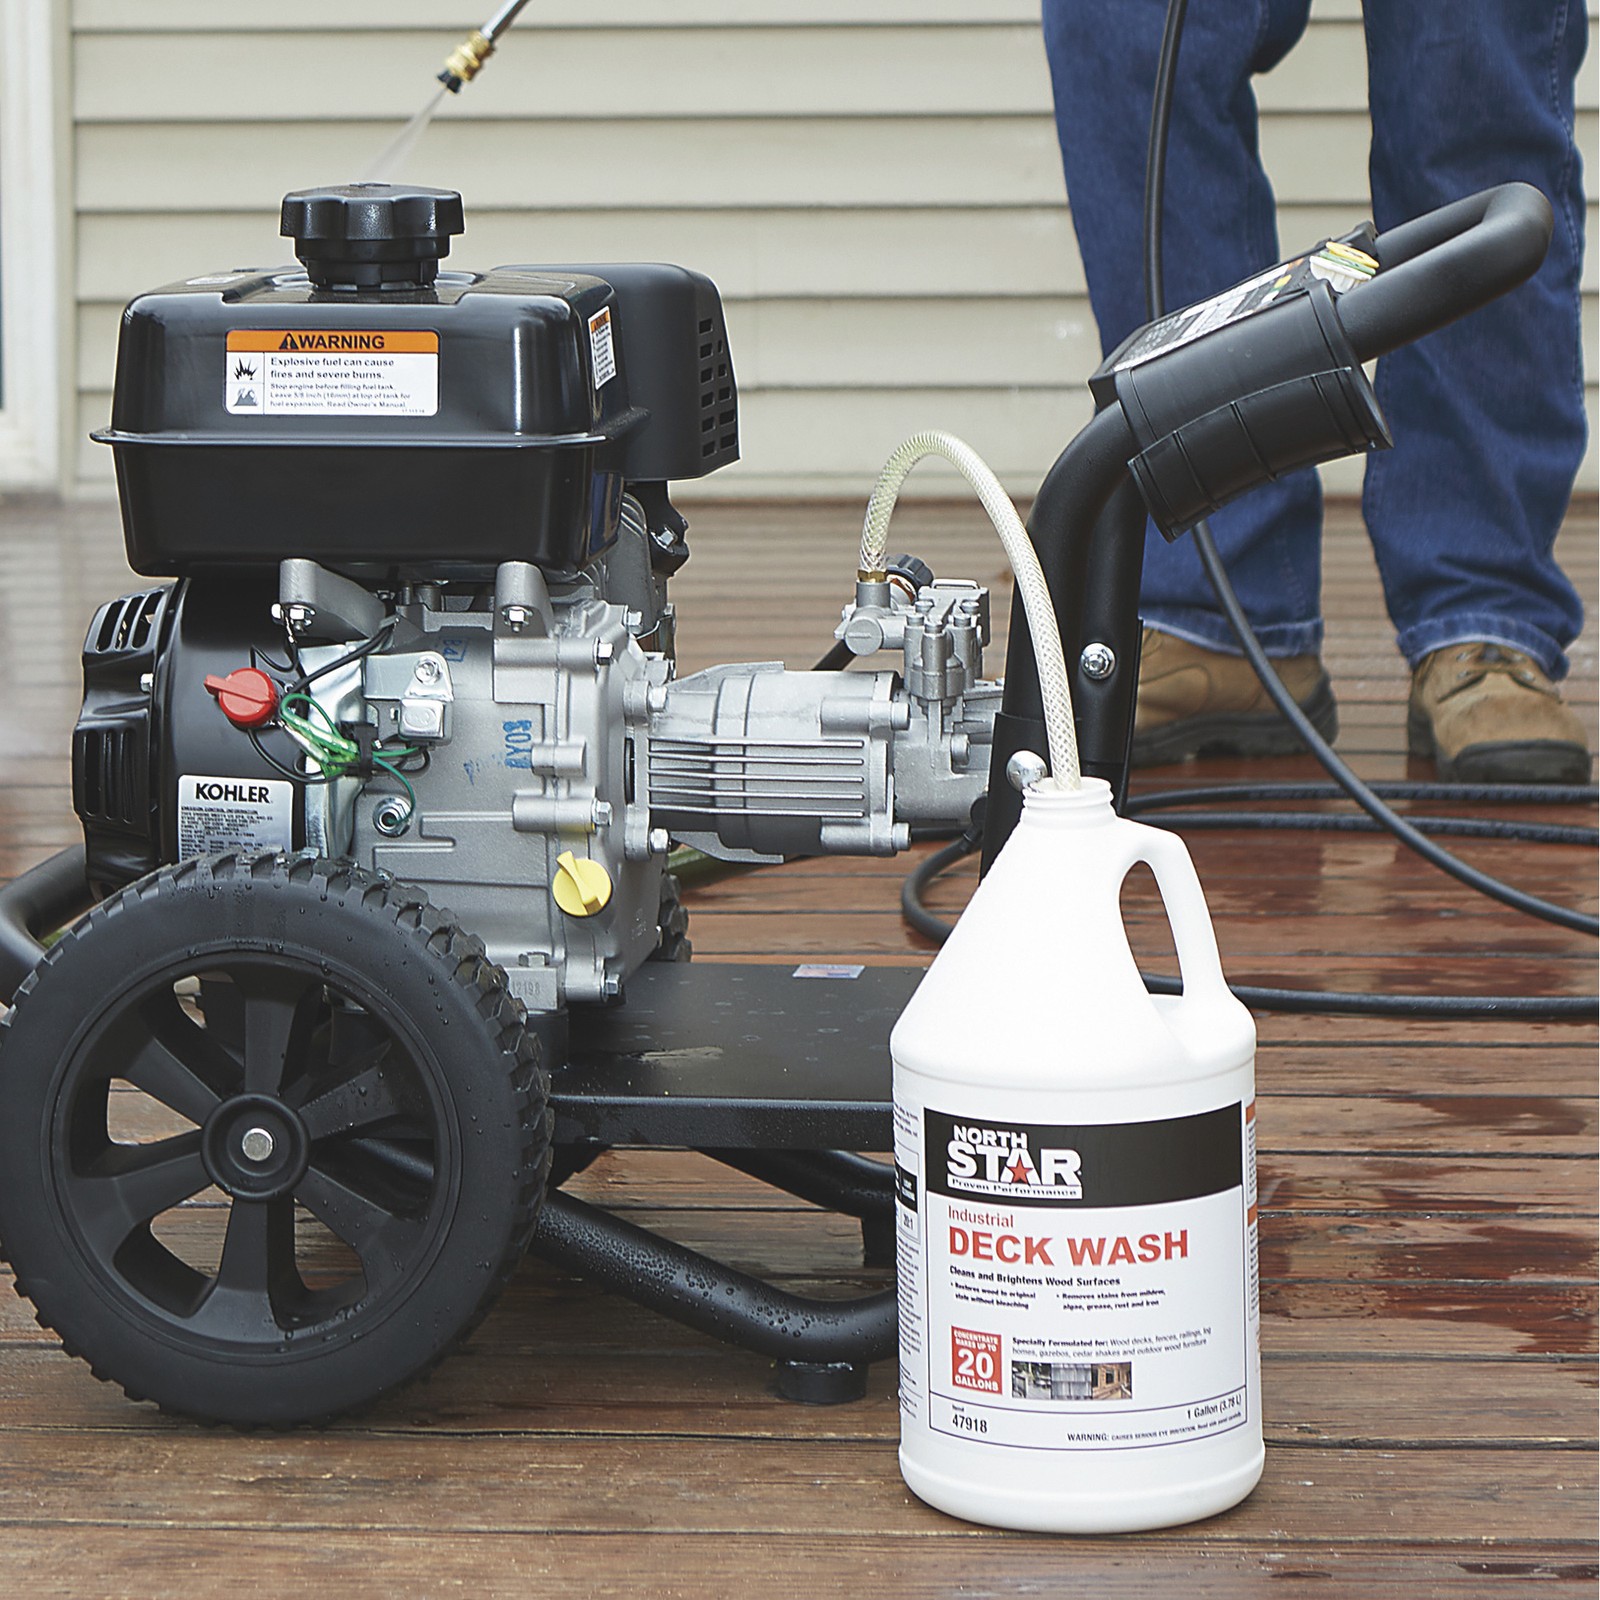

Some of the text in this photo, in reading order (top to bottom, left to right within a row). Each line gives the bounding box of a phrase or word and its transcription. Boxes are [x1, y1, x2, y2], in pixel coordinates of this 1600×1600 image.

[298, 334, 385, 349] WARNING
[270, 357, 320, 367] Explosive
[322, 357, 342, 366] fuel
[364, 359, 395, 367] cause
[270, 370, 293, 378] fires
[295, 371, 314, 379] and
[352, 370, 385, 379] burns.
[195, 782, 271, 804] KOHLER
[953, 1124, 1028, 1149] NORTH
[946, 1139, 1083, 1187] STAR
[952, 1177, 1077, 1197] Proven Performance
[947, 1204, 1014, 1228] Industrial
[949, 1225, 1188, 1267] DECK WASH
[949, 1265, 1121, 1287] Cleans and Brightens Wood Surfaces
[1012, 1337, 1046, 1347] Specially
[1048, 1339, 1093, 1347] Formulated
[957, 1348, 994, 1380] 20
[954, 1374, 999, 1392] GALLONS
[1194, 1404, 1219, 1418] Gallon
[952, 1413, 988, 1434] 47918
[1067, 1432, 1110, 1441] WARNING:
